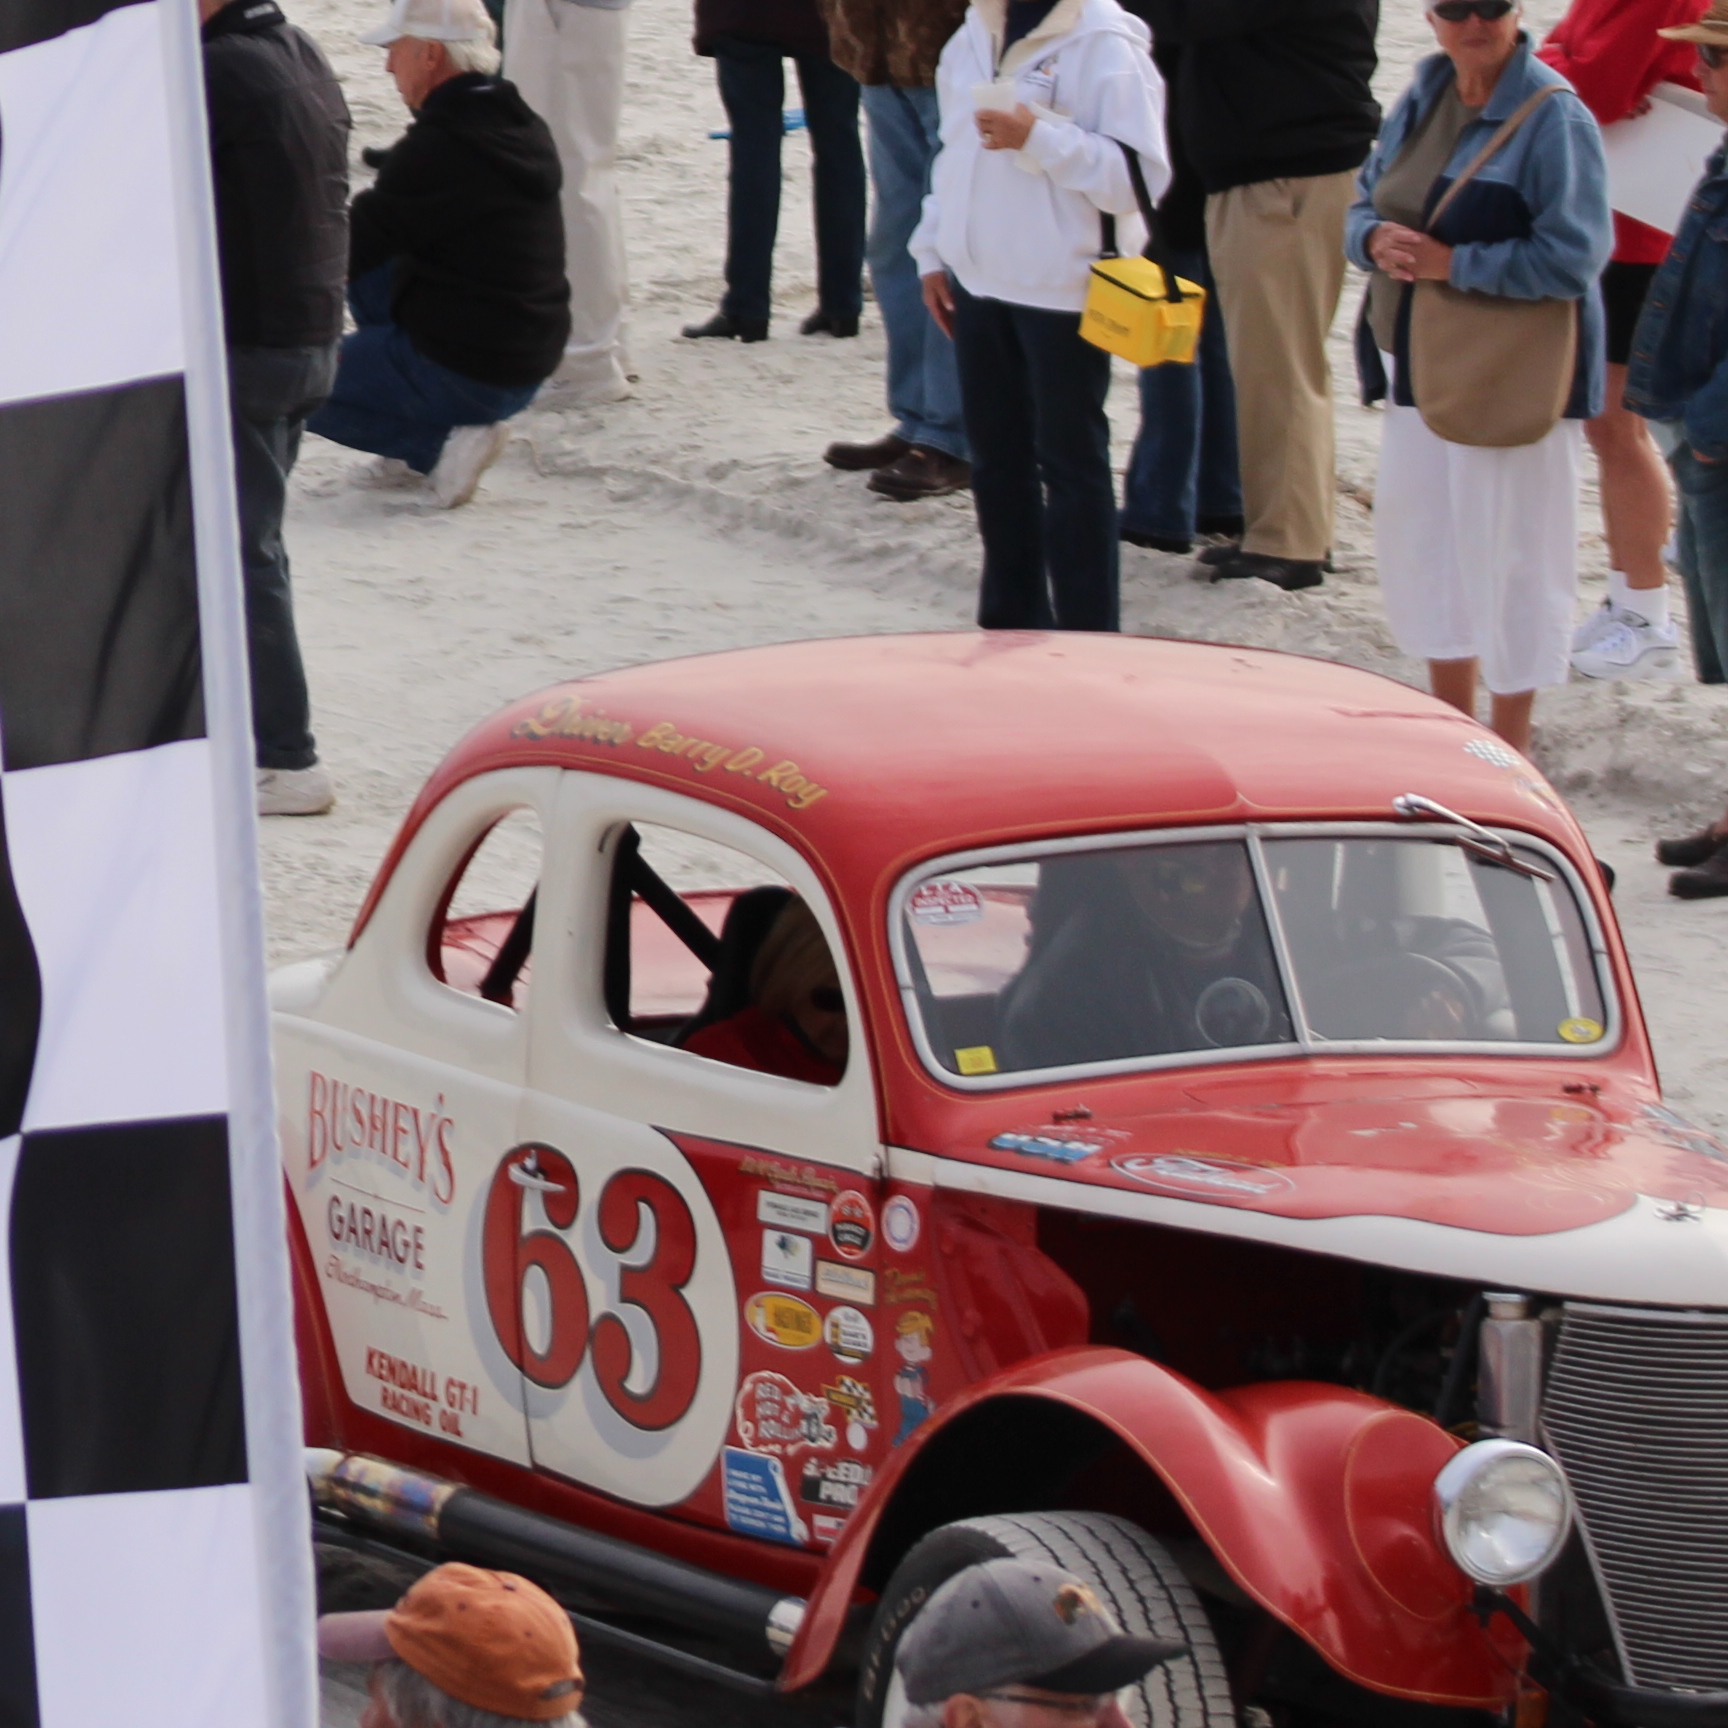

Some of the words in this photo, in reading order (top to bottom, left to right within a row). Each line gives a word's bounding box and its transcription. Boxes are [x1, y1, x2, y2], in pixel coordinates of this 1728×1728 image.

[635, 722, 733, 773] Barry
[755, 759, 829, 810] Roy
[308, 1070, 456, 1205] BUSHEY'S
[327, 1194, 426, 1271] GARAGE
[481, 1142, 702, 1431] 63
[365, 1345, 439, 1403] KENDALL
[379, 1385, 433, 1428] RACING
[438, 1408, 464, 1438] OIL
